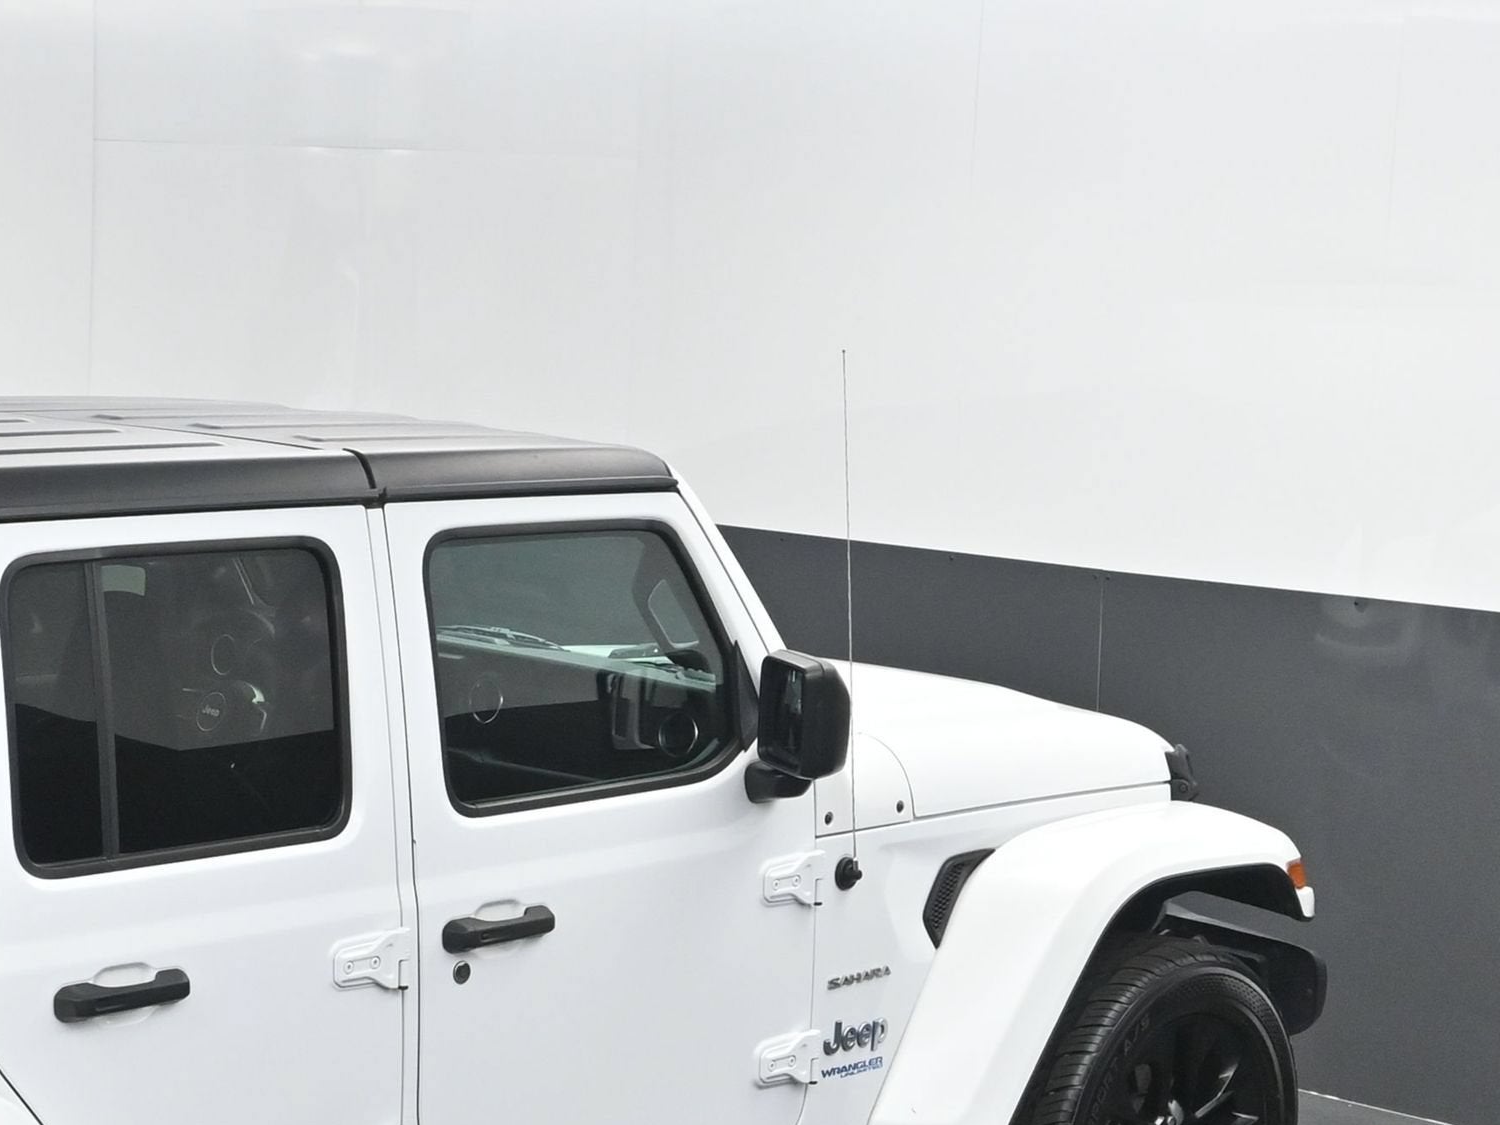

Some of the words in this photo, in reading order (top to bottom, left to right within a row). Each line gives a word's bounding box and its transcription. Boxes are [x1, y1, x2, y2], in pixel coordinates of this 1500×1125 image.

[827, 965, 891, 990] SAHARA
[823, 1017, 888, 1056] Jeep
[821, 1056, 883, 1078] WRANGLER
